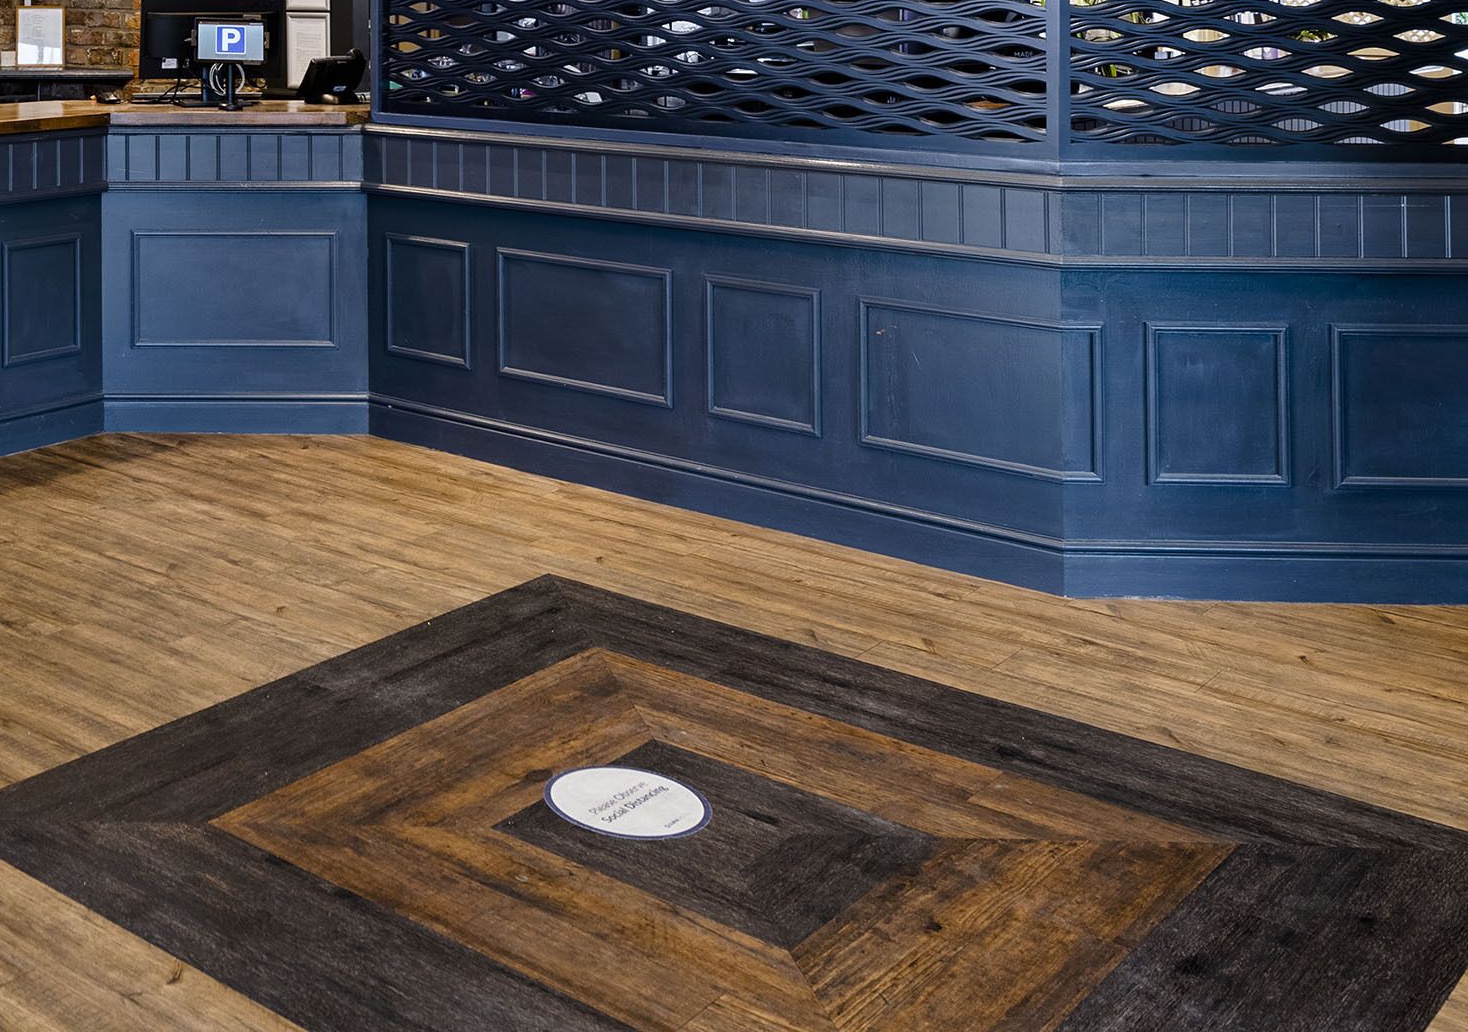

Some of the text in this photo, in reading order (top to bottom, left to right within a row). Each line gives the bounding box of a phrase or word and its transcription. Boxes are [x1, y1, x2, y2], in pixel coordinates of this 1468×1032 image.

[221, 28, 241, 52] P
[601, 785, 669, 823] Social Distancing
